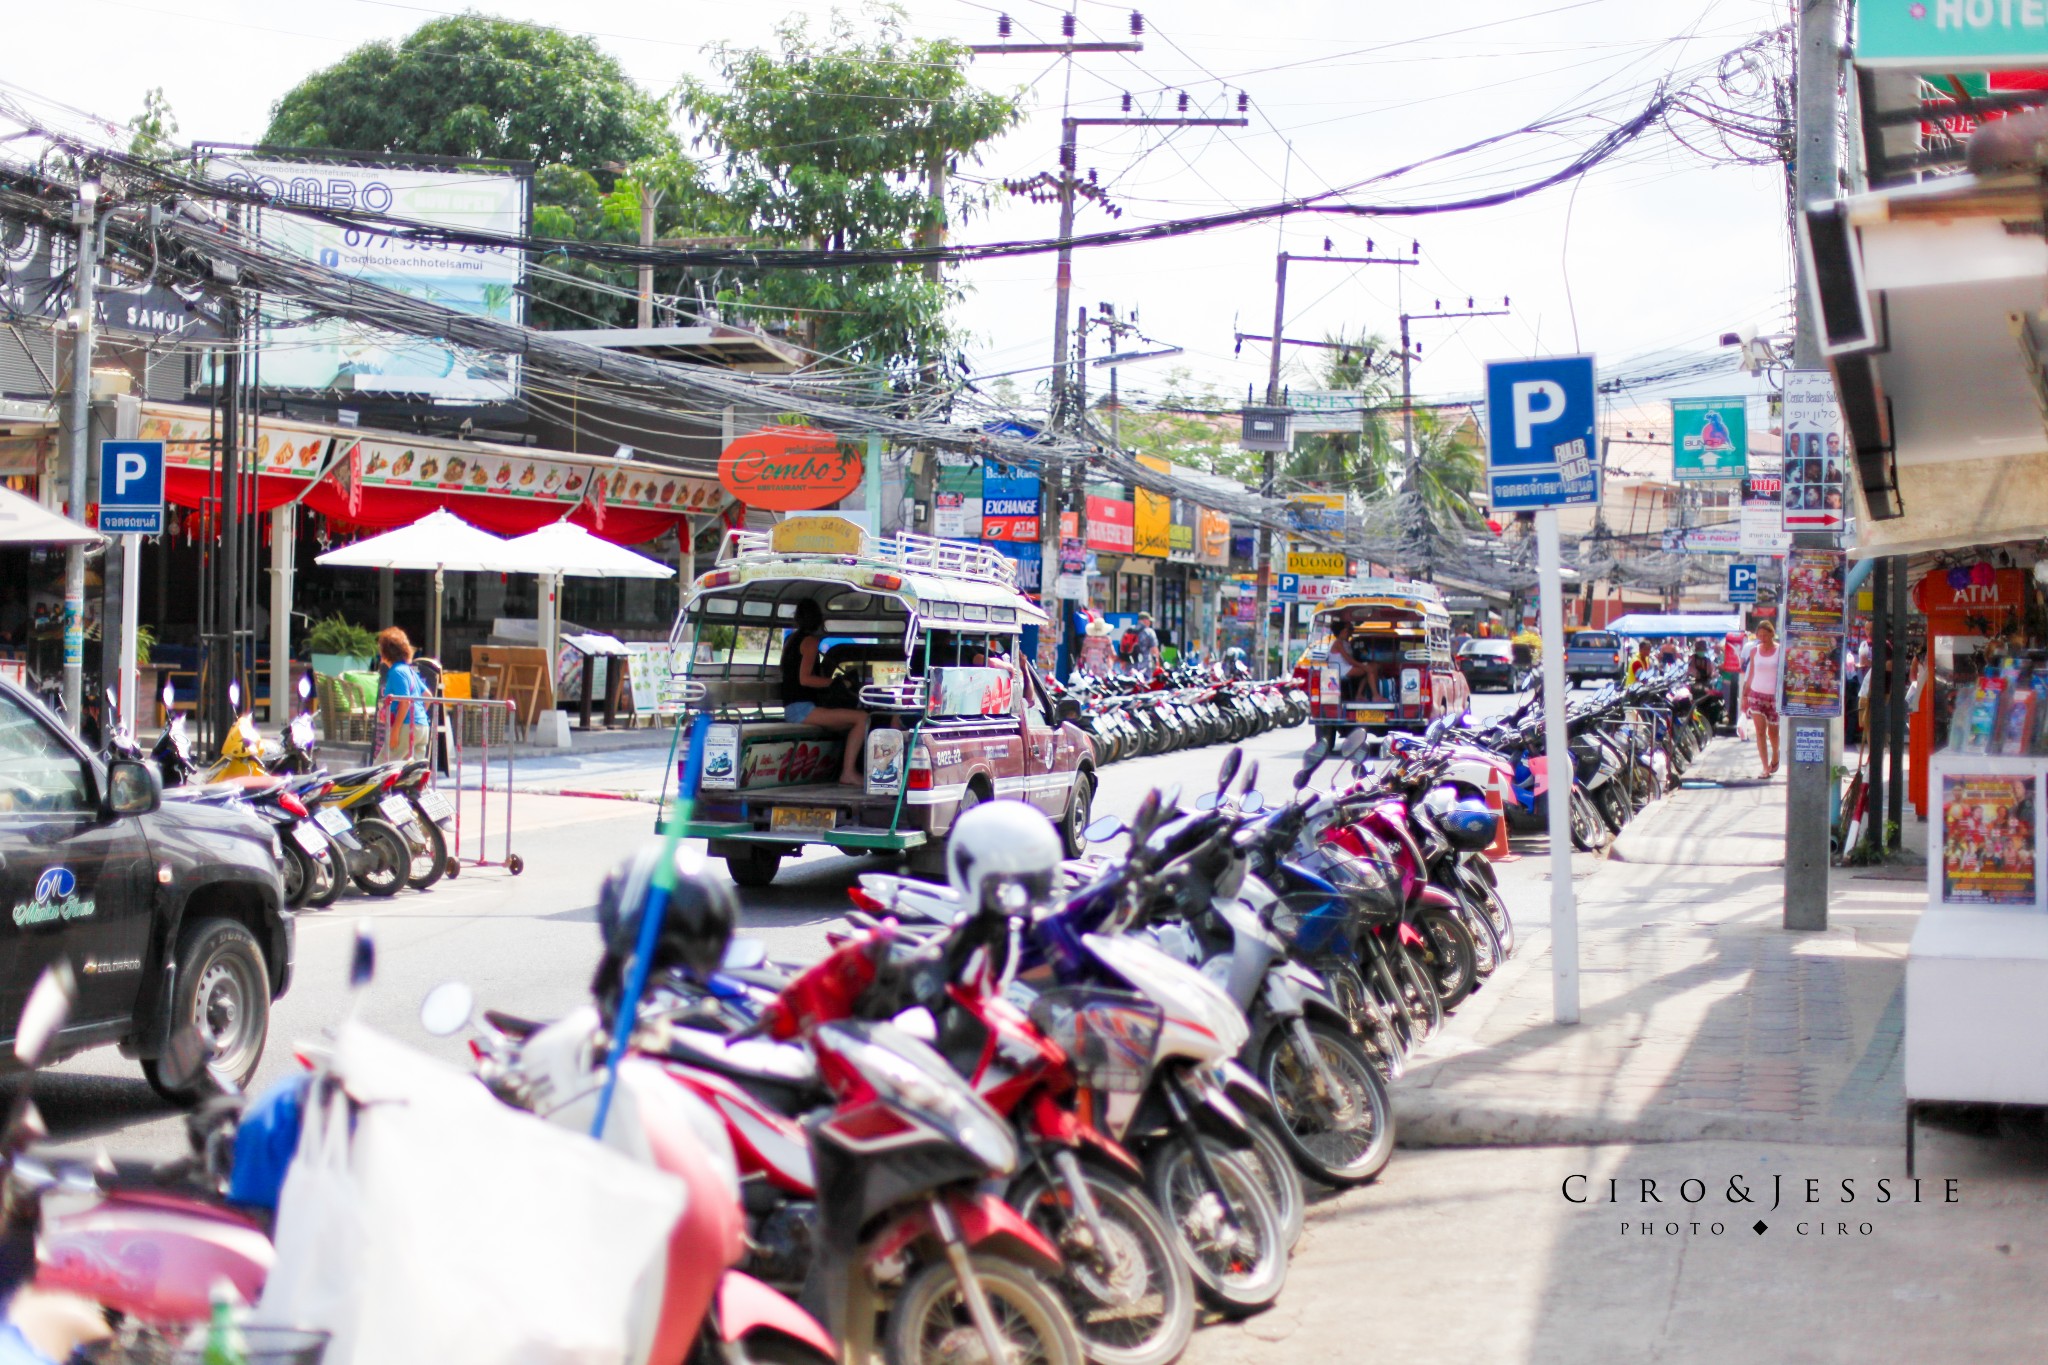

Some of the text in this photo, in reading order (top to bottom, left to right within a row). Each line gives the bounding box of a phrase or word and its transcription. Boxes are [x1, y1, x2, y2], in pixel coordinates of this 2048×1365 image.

[127, 306, 184, 334] SAMUI
[1512, 380, 1567, 449] P
[116, 453, 147, 495] P
[985, 499, 1037, 515] EXCHANGE
[104, 514, 156, 528] จอดรถยนต์
[1013, 521, 1036, 531] ATM
[1289, 557, 1344, 568] DUOMO
[1282, 576, 1294, 591] P
[1735, 569, 1750, 588] P
[1953, 584, 1999, 603] ATM
[936, 749, 962, 766] 8422-22
[97, 959, 141, 973] COLORADO
